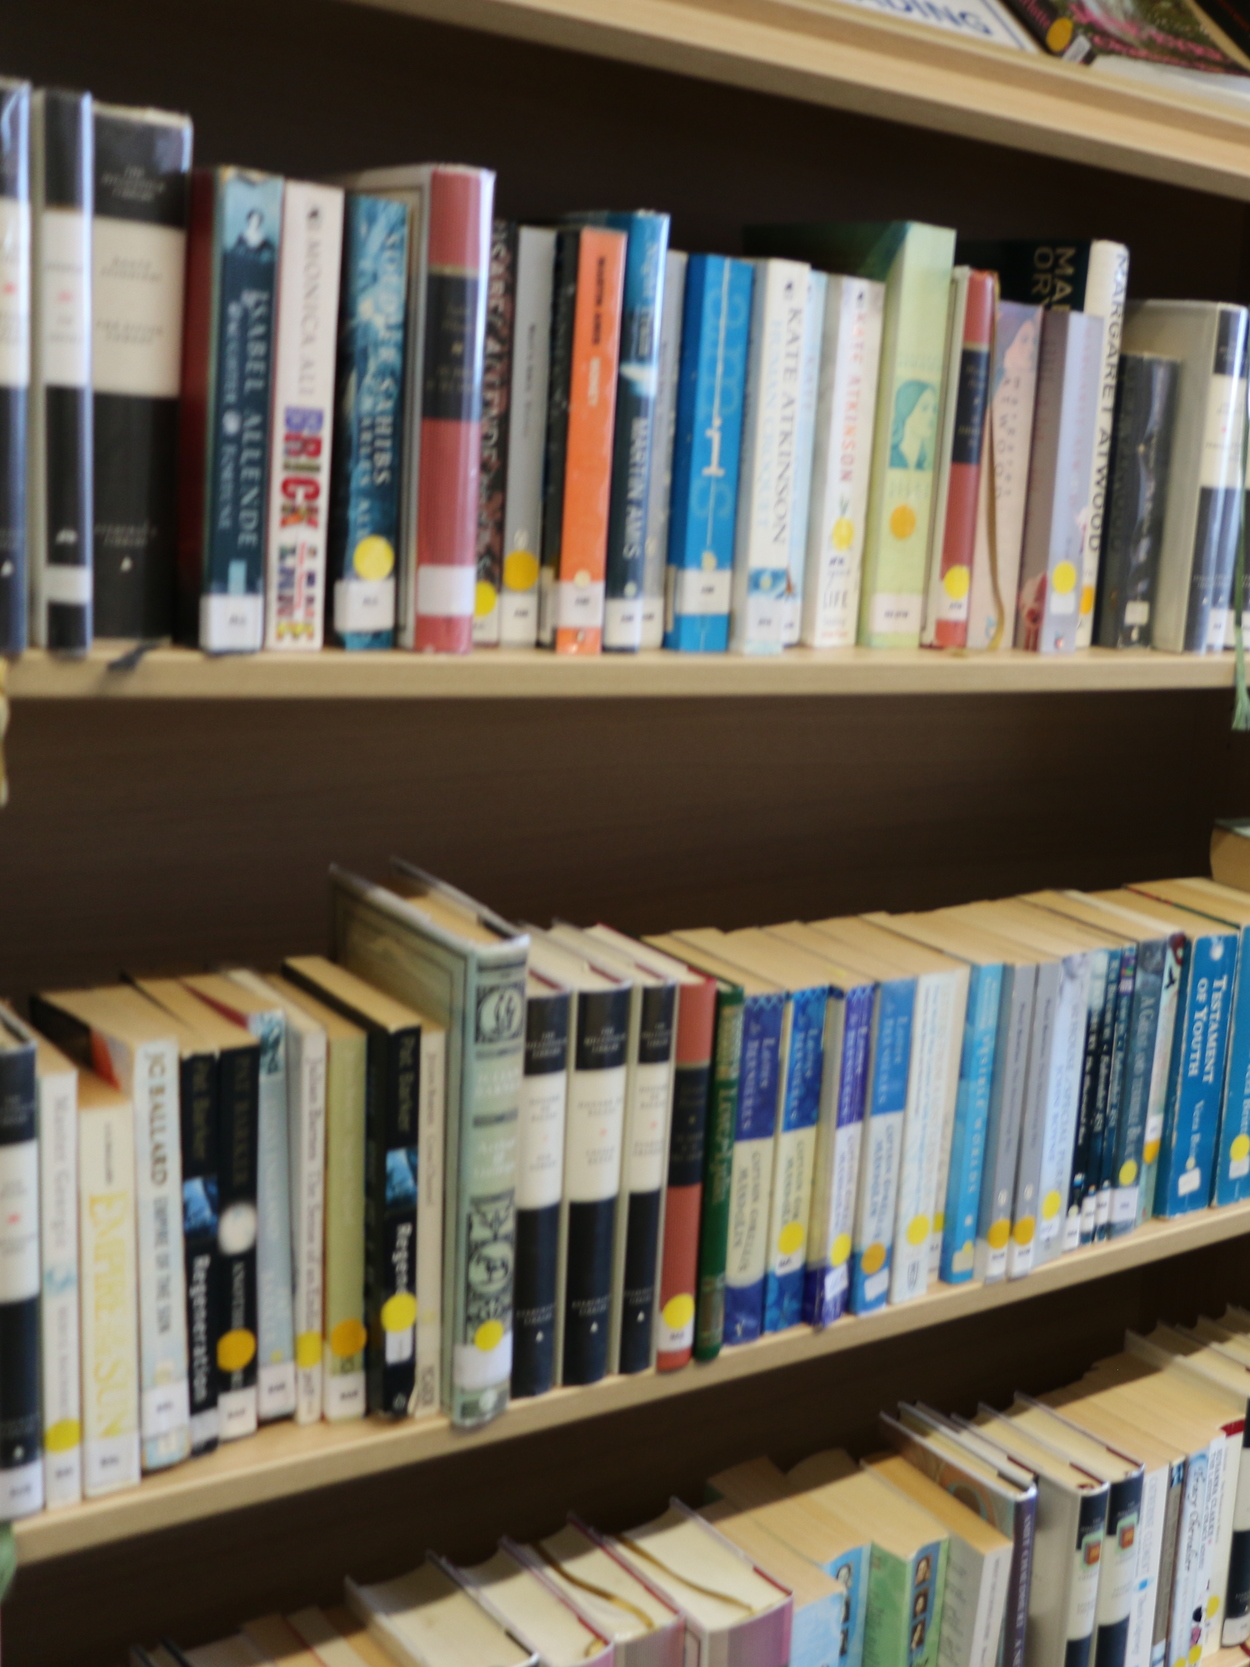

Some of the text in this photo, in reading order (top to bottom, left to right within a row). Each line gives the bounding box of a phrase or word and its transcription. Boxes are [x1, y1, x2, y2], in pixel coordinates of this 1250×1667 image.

[299, 240, 322, 397] MONICA ALI
[1100, 251, 1129, 416] MARGARET
[238, 290, 270, 549] ISABEL ALLENDE
[372, 377, 395, 484] SAHIBS
[772, 307, 804, 545] KATE ATKINSON
[839, 312, 867, 483] KATE ATKINSON
[279, 405, 323, 530] BRICK
[621, 417, 651, 559] MARTIN AMIS
[1087, 427, 1112, 553] ATWOOD
[306, 1056, 325, 1099] Julian
[1187, 977, 1210, 1078] OF YOUTH
[1201, 974, 1229, 1084] TESTAMENT
[149, 1084, 169, 1186] BALLARD
[306, 1103, 322, 1161] Barnes
[1191, 1099, 1207, 1131] Vera
[306, 1171, 323, 1197] The
[306, 1202, 321, 1242] Sense
[88, 1188, 129, 1312] EMPIRE
[154, 1252, 172, 1271] OF
[155, 1274, 172, 1303] THE
[230, 1261, 246, 1330] ANOTHE
[156, 1306, 173, 1334] SUN
[190, 1253, 212, 1403] Regeneration
[305, 1290, 324, 1332] Endin
[1183, 1466, 1207, 1572] Tracy Chevalier
